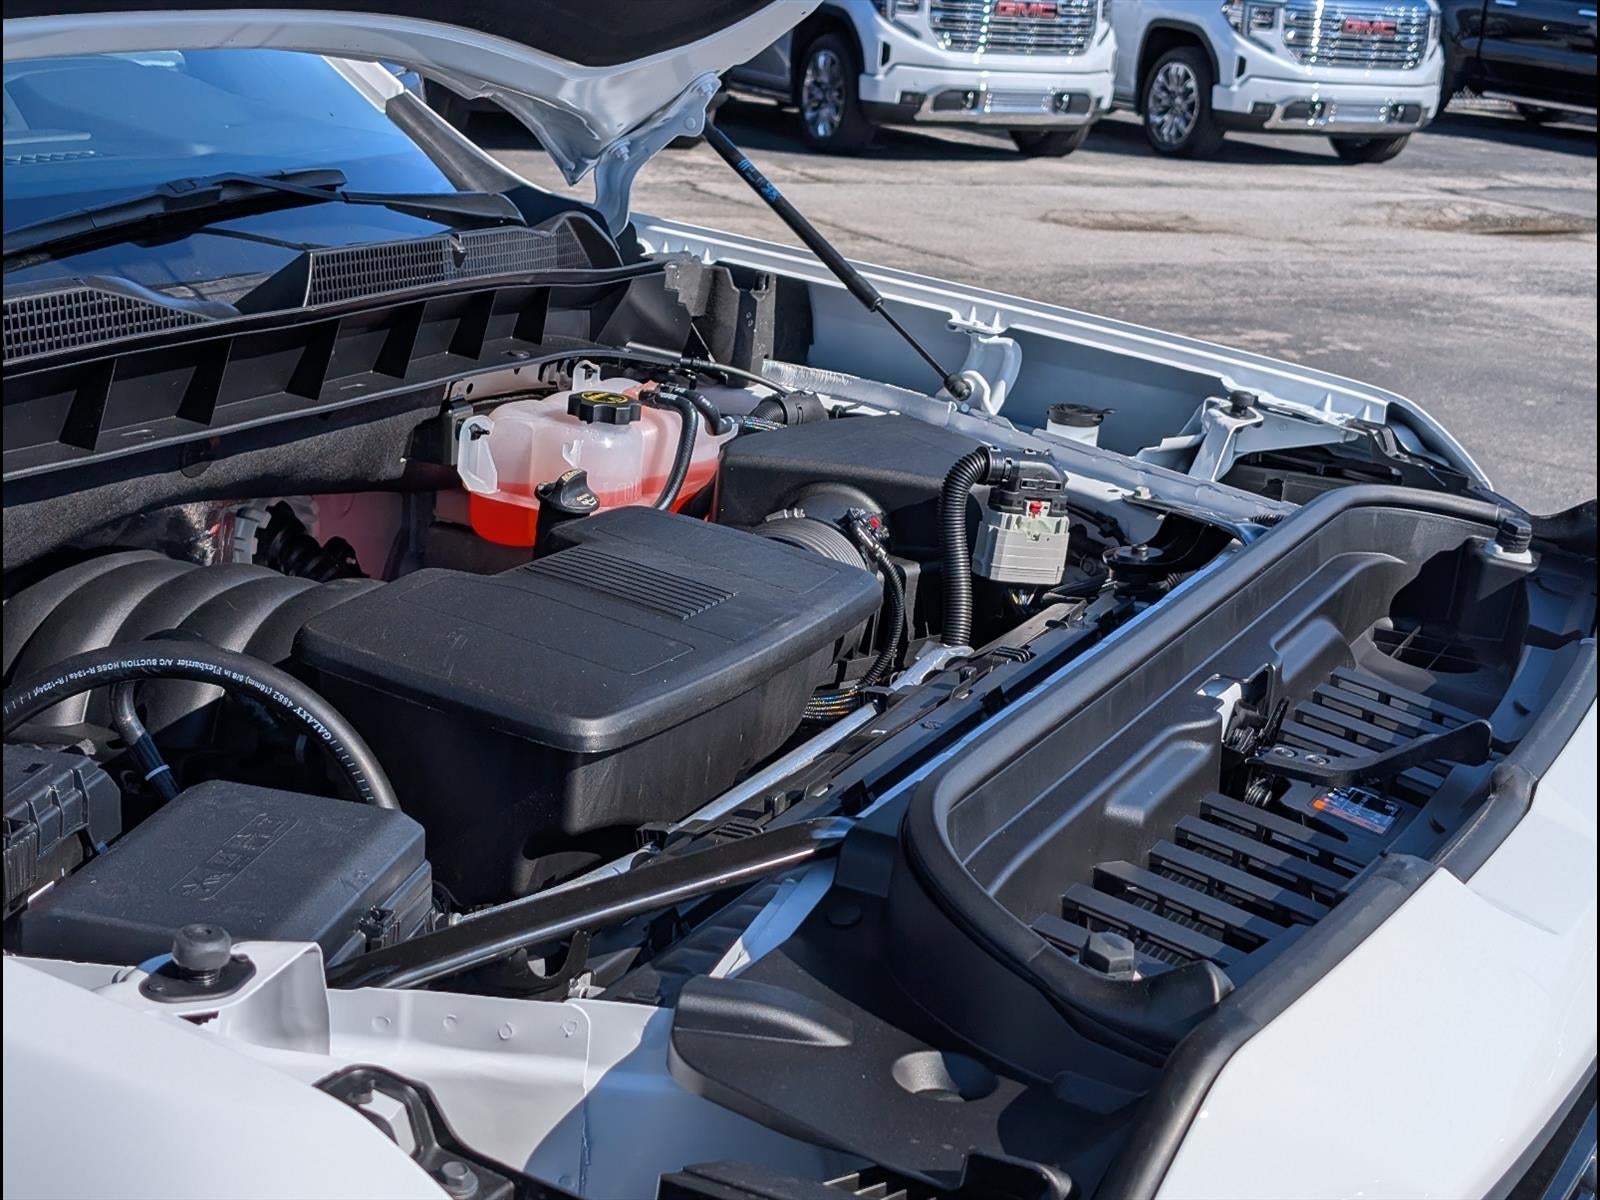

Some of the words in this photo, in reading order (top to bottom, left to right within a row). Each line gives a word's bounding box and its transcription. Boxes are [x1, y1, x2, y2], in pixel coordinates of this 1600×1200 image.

[995, 2, 1057, 18] GMC
[1343, 20, 1397, 35] GMC
[97, 661, 120, 673] HOSE
[121, 658, 157, 668] SUCTION
[160, 658, 173, 667] A/C
[176, 658, 222, 676] Flexbarrier
[69, 666, 96, 680] R-134a
[245, 675, 272, 694] (16mm)
[293, 706, 332, 740] GALAXY
